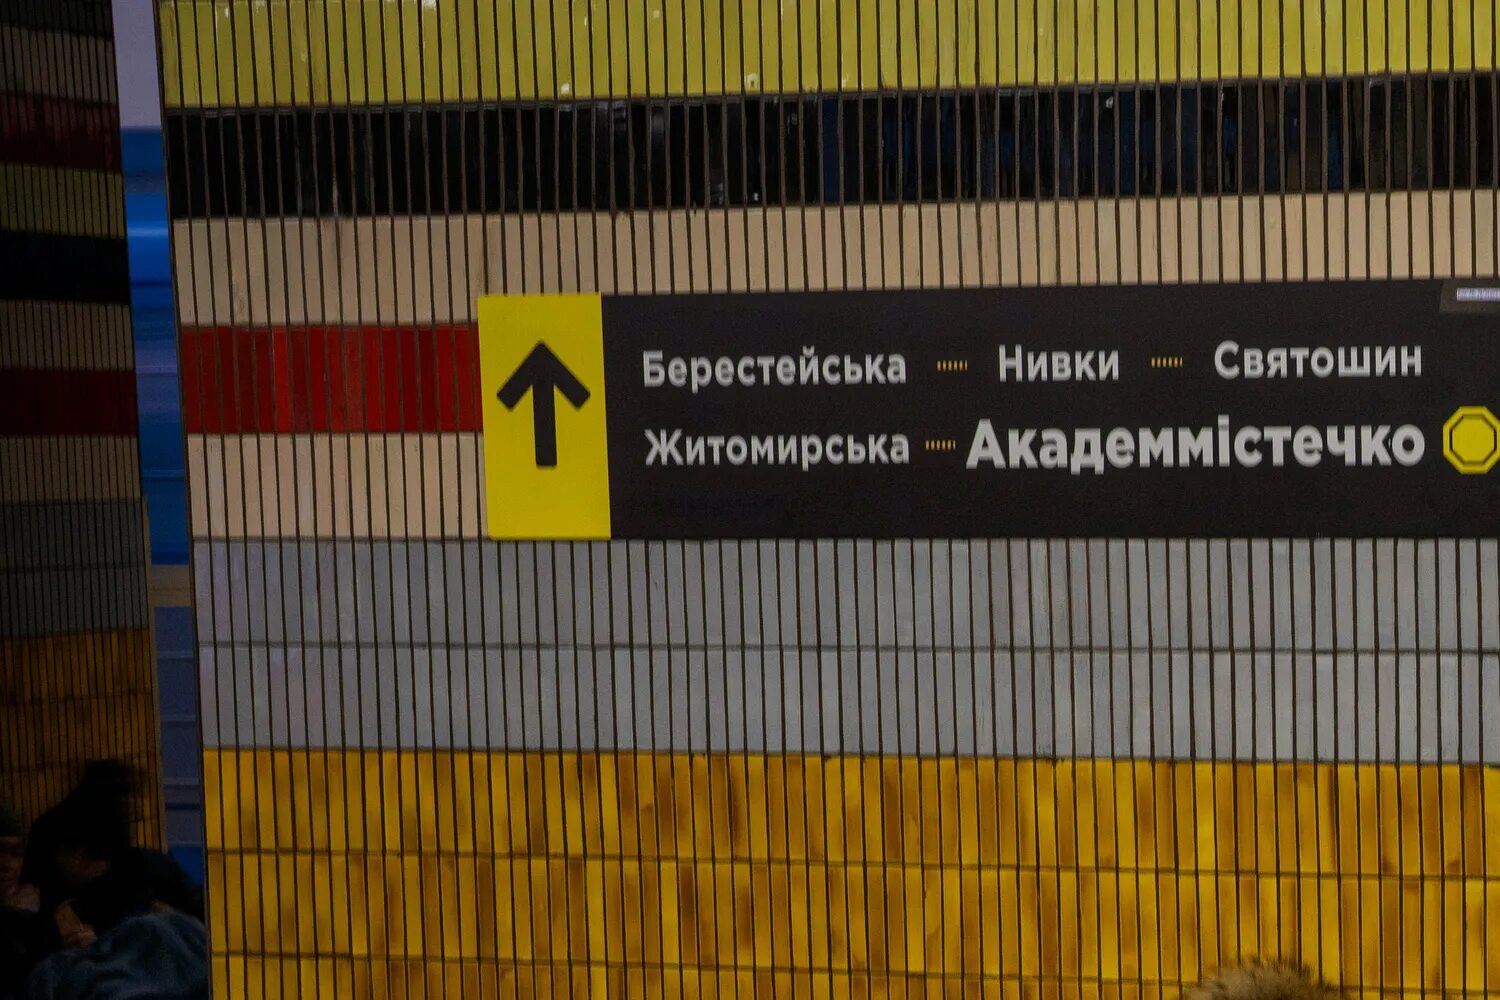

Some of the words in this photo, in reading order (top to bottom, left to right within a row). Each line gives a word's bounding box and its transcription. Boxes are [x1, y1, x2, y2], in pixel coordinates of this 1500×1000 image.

[642, 345, 907, 393] Берестейська
[998, 344, 1119, 382] Нивки
[1214, 340, 1422, 379] Святошин
[644, 428, 910, 472] Житомирська
[966, 414, 1426, 475] Академмістечко
